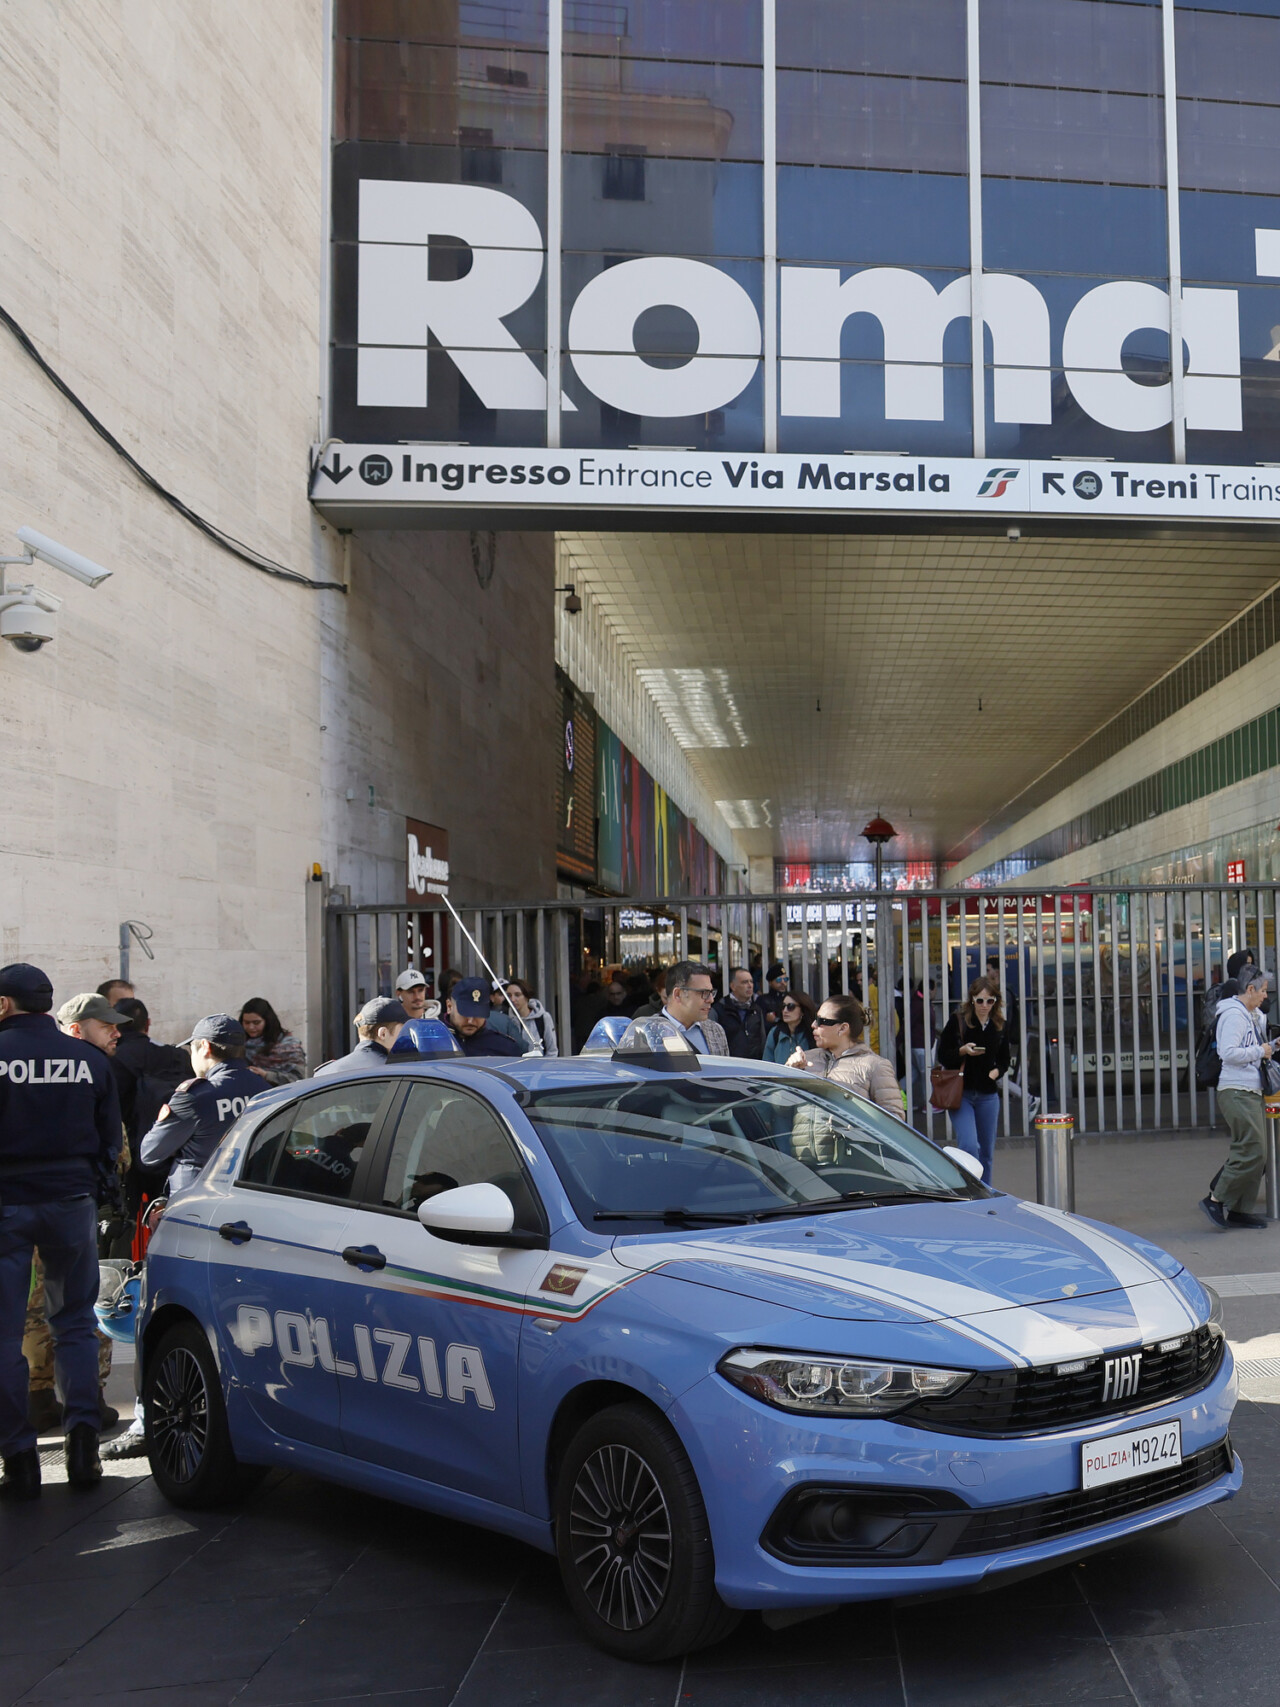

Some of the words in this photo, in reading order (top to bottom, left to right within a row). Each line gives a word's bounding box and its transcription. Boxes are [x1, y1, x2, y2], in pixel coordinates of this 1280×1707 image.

[402, 454, 571, 491] Ingresso
[579, 458, 713, 488] Entrance
[721, 461, 784, 489] Via
[797, 463, 951, 493] Marsala
[1111, 471, 1198, 499] Treni
[236, 1303, 497, 1412] POLIZIA
[1102, 1353, 1142, 1402] FIAT
[1086, 1450, 1128, 1473] POLIZIA
[1132, 1432, 1177, 1467] M9242
